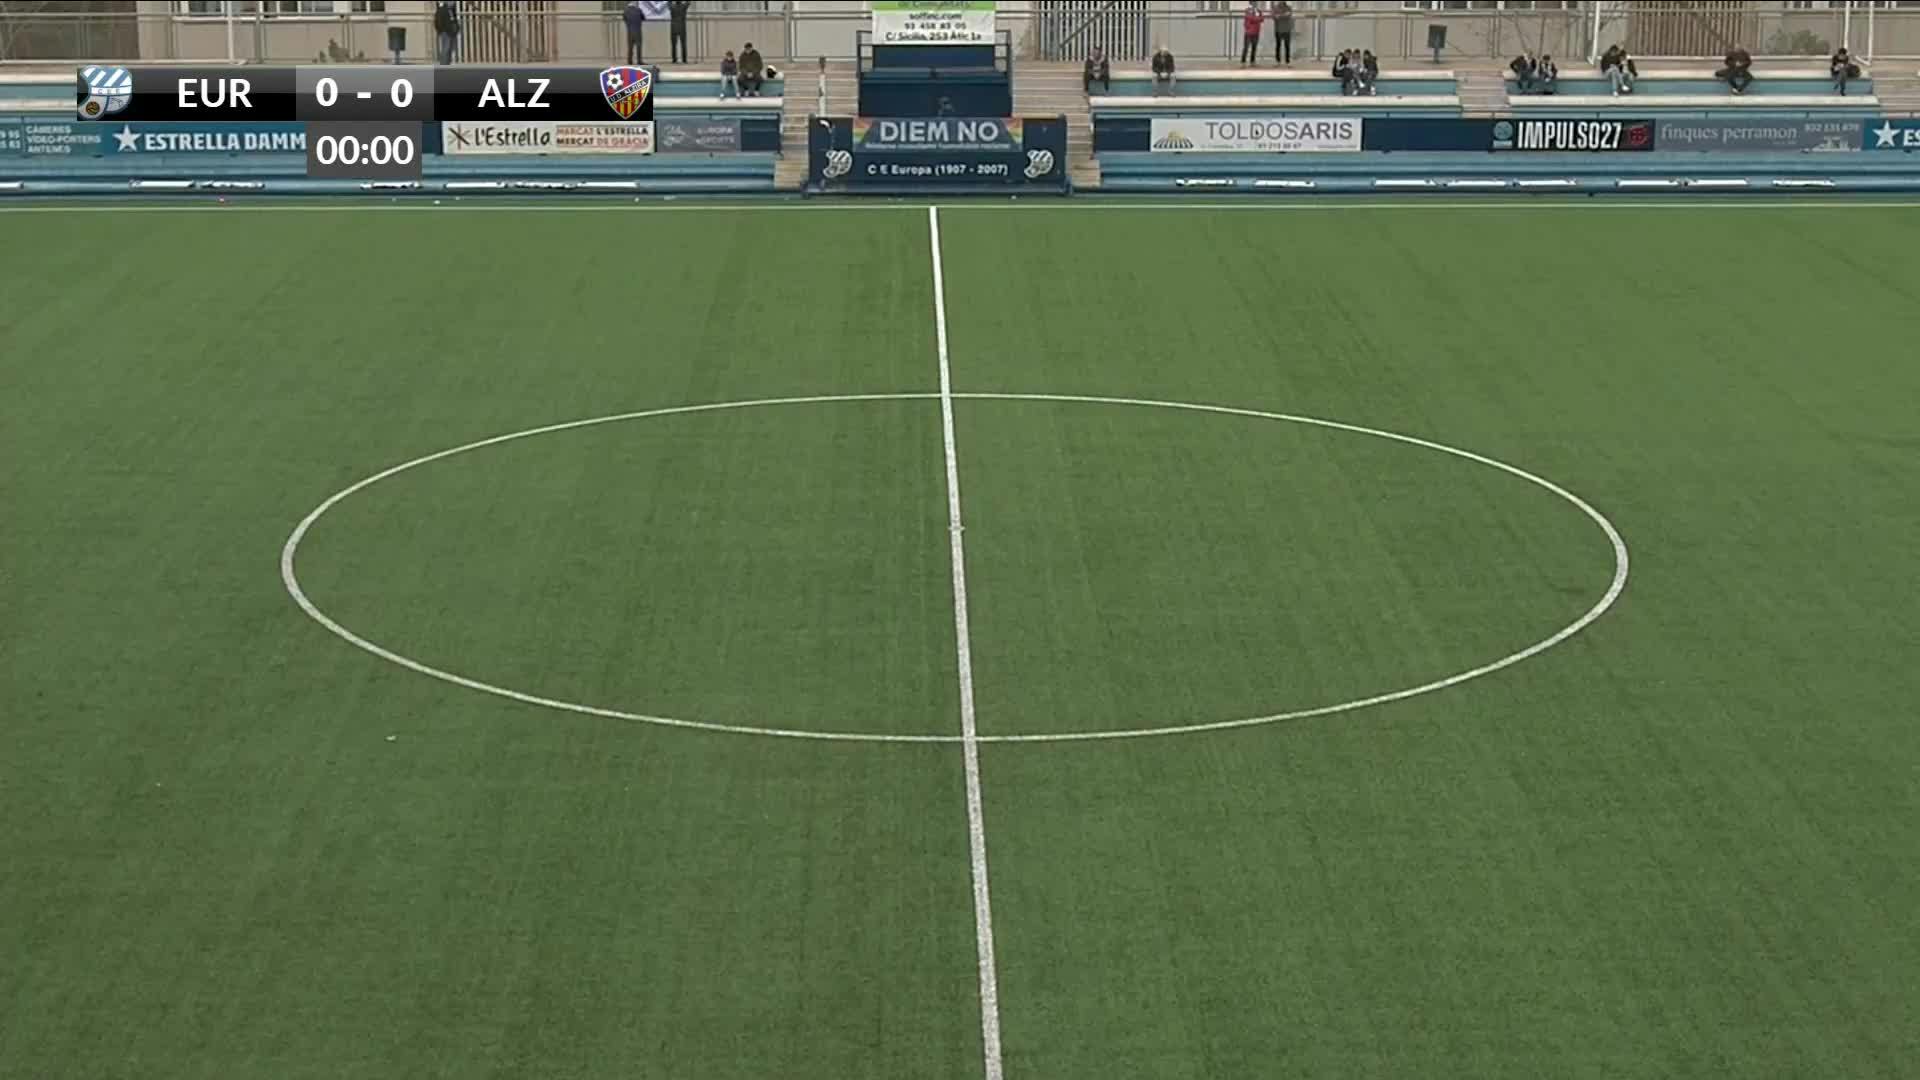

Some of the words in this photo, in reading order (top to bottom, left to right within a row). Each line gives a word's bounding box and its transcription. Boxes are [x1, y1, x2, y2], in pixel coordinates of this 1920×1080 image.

[880, 121, 949, 142] DIEM
[958, 121, 999, 142] NO
[1661, 124, 1719, 143] finques
[1723, 127, 1798, 144] perramon
[144, 133, 241, 150] ESTRELLA
[244, 133, 306, 150] DAMM
[891, 164, 932, 176] Europa
[935, 164, 966, 176] (1907
[977, 164, 1008, 176] 2007)
